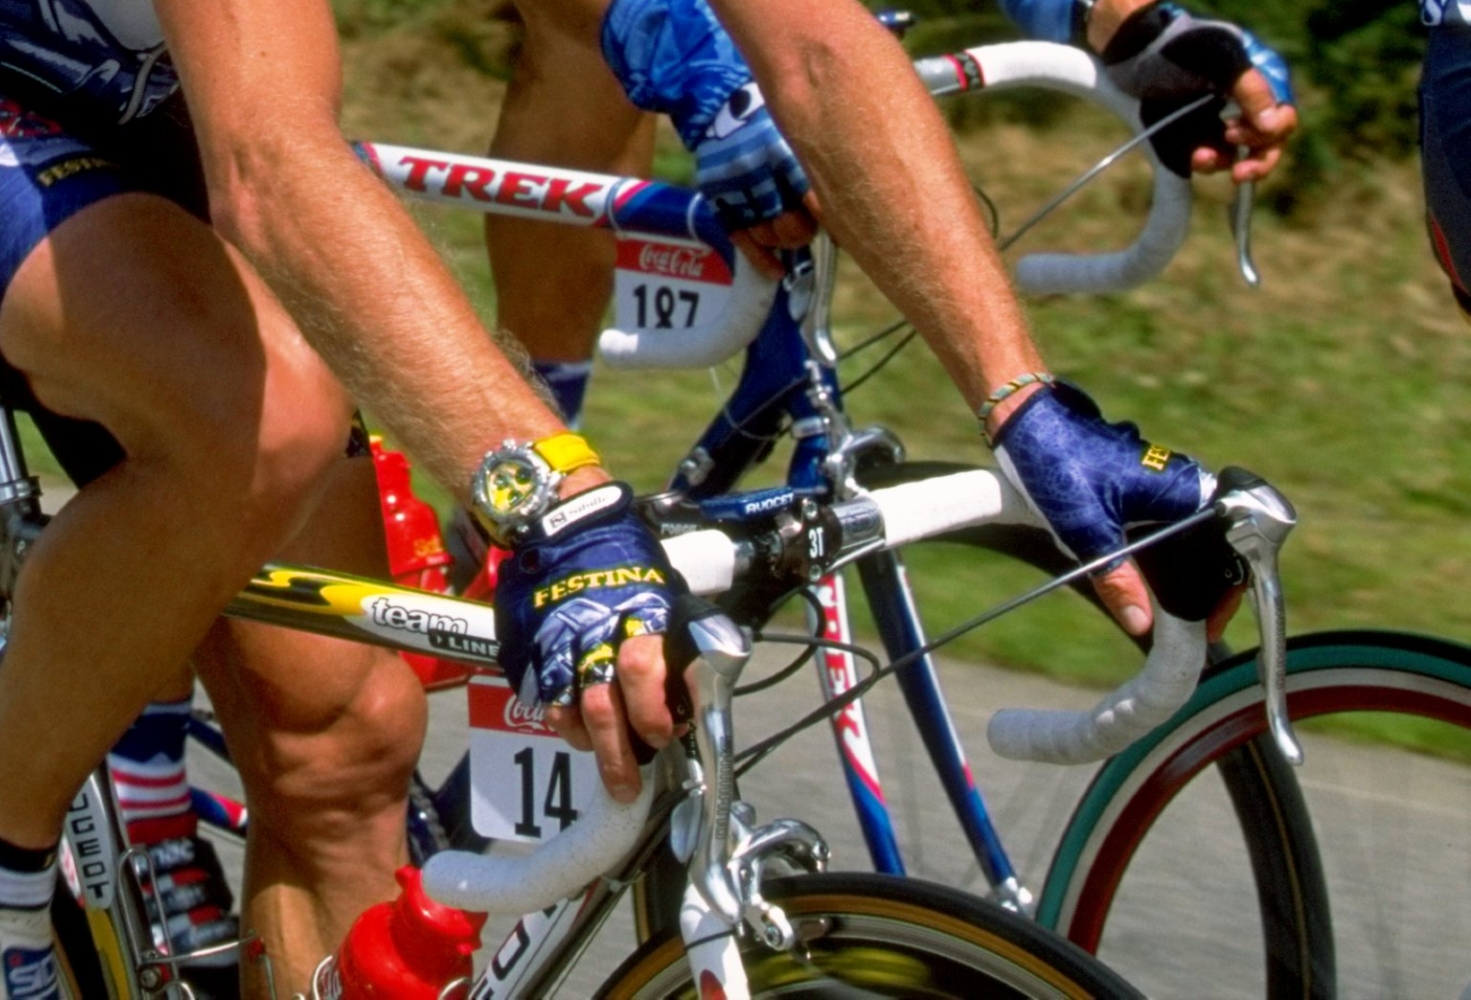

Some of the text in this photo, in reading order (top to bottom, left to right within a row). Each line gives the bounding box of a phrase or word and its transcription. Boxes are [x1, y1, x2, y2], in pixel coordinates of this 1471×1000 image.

[397, 154, 609, 218] TREK
[808, 526, 826, 559] 3T
[533, 566, 666, 608] FESTINA
[372, 597, 469, 634] team
[514, 746, 578, 838] 14
